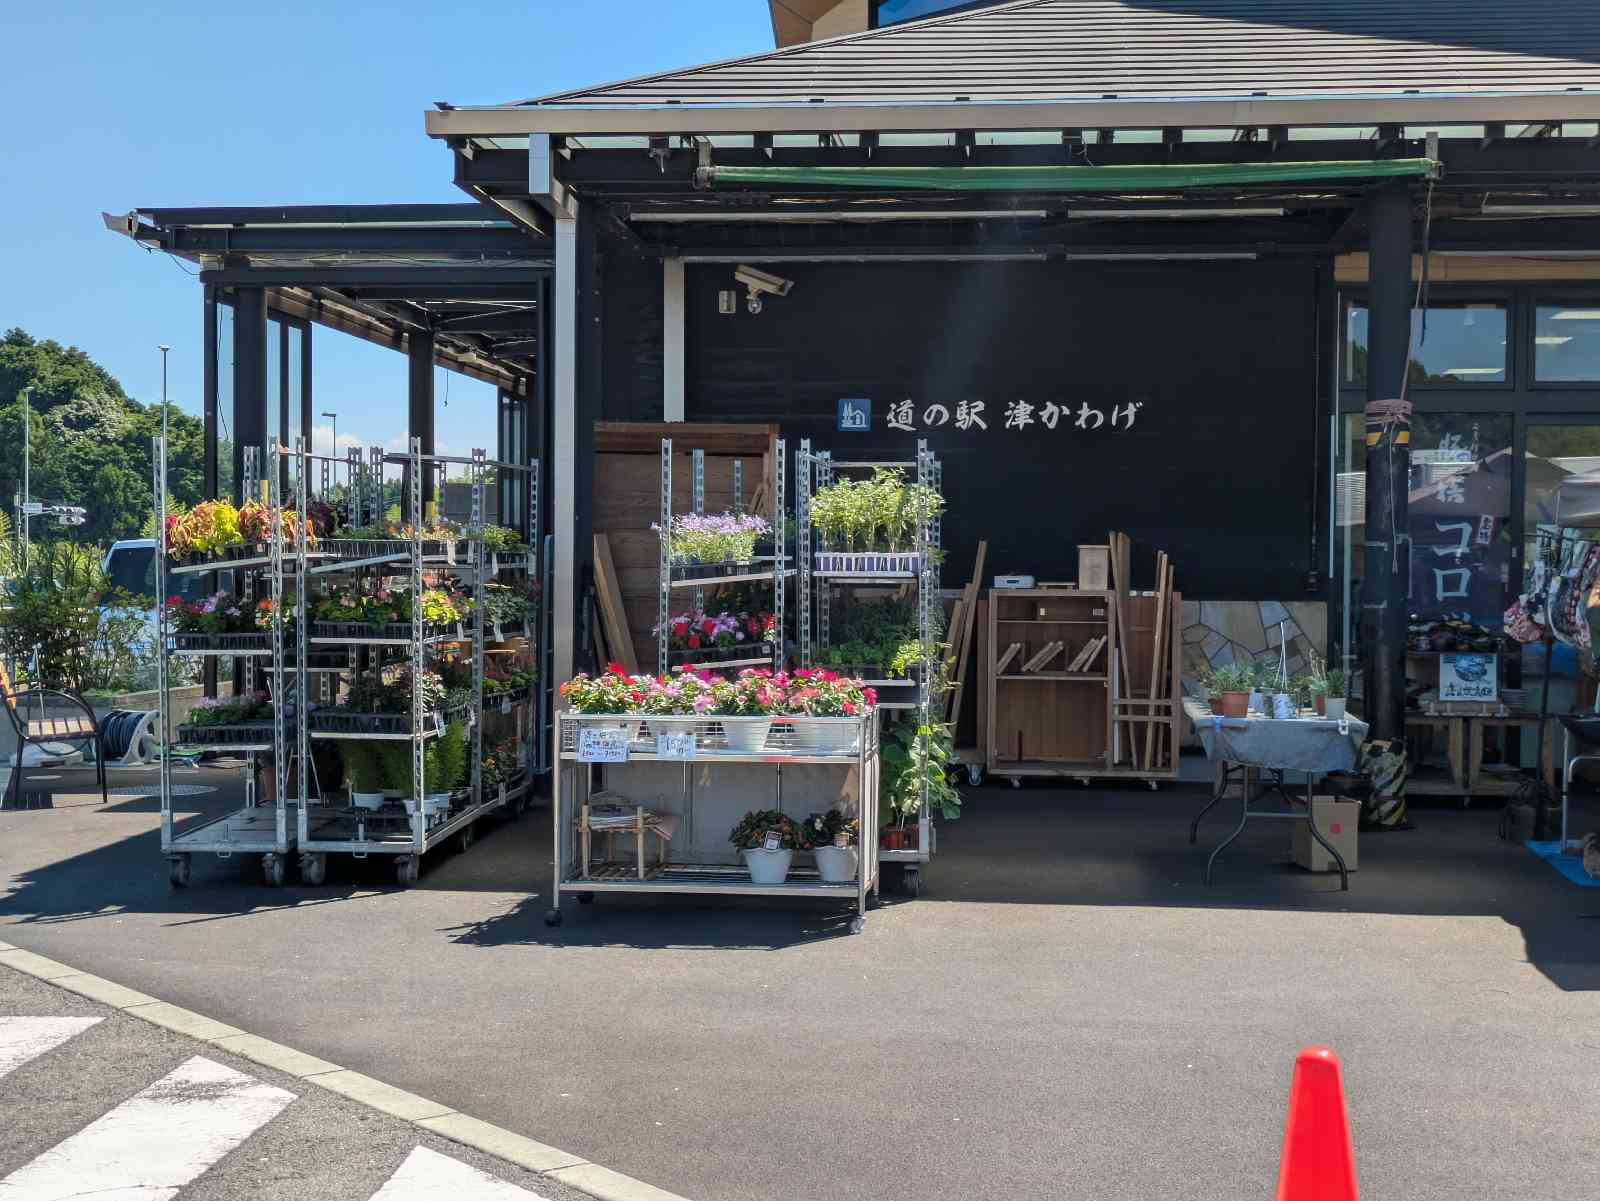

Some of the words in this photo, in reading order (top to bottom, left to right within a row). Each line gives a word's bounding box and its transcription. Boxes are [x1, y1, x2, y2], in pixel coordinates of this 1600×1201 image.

[886, 398, 988, 431] 道の駅
[1004, 399, 1144, 431] 津かわげ
